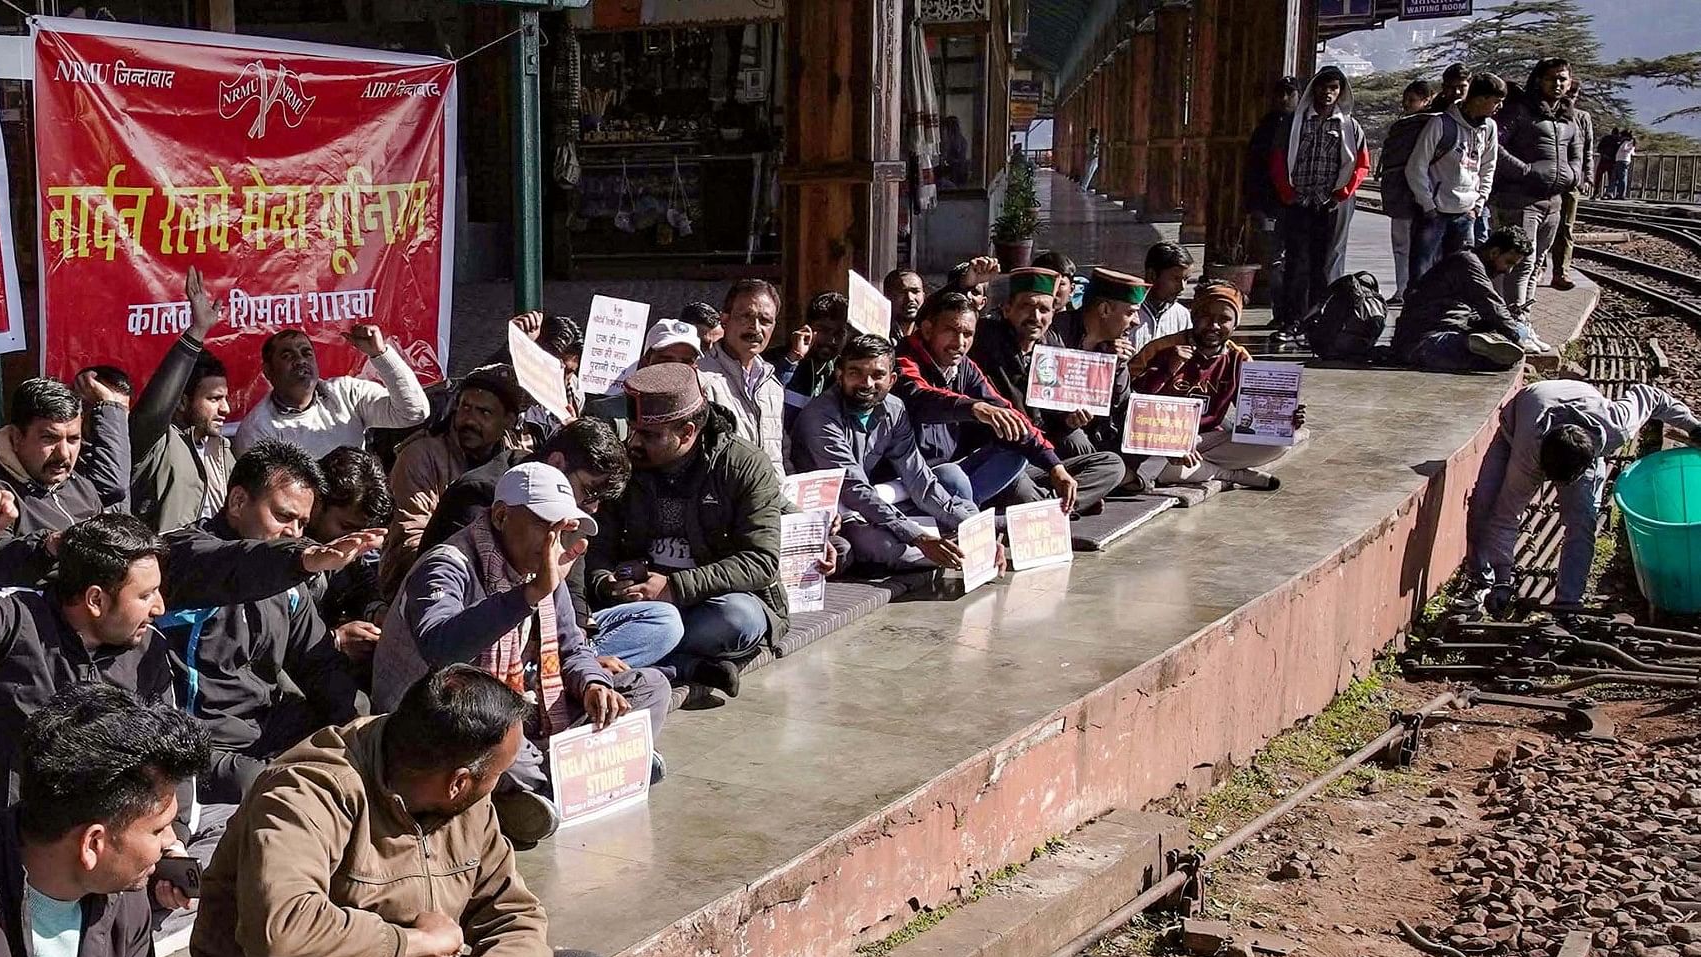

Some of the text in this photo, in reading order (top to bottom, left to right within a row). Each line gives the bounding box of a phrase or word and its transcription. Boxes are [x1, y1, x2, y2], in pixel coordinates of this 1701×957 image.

[1407, 5, 1440, 14] WAITING
[1442, 2, 1467, 11] ROOM
[54, 59, 176, 89] NRMU जिन्दाबाद
[360, 81, 396, 98] AIRF
[222, 77, 259, 107] NRMU
[279, 81, 306, 115] NRMU
[48, 164, 429, 275] नार्दन रेलवे मेन्स यूनियन
[229, 288, 303, 329] शिमला
[307, 288, 377, 322] शाखा
[559, 736, 646, 780] RELAY HUNGER
[585, 765, 627, 796] STRIKE
